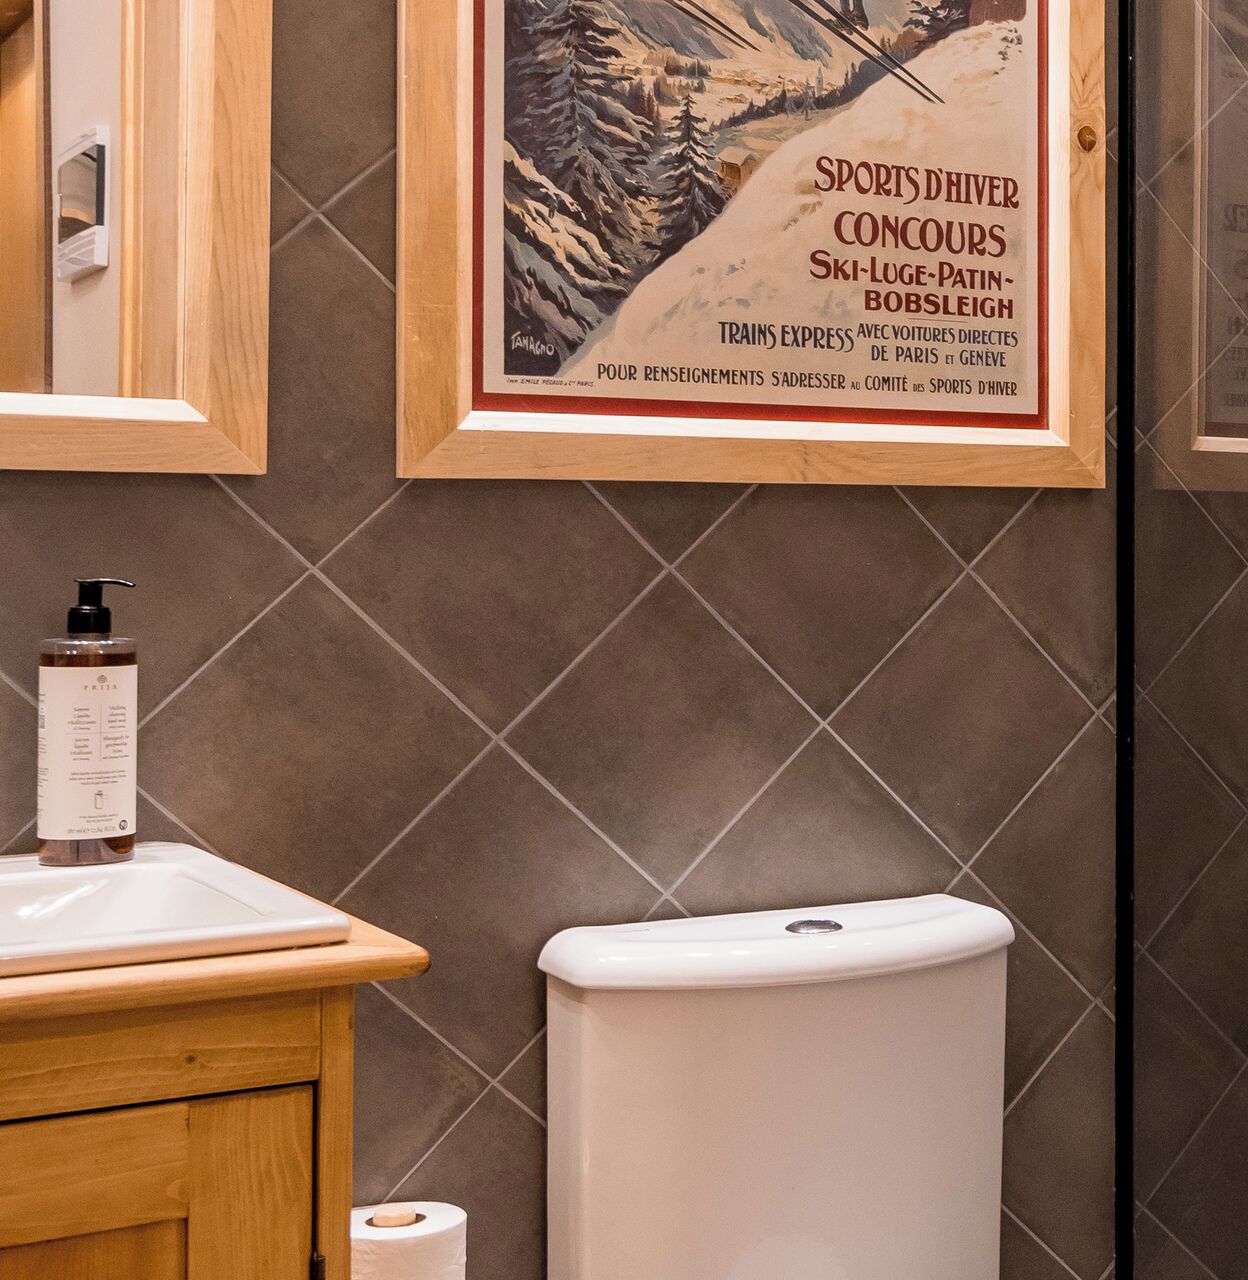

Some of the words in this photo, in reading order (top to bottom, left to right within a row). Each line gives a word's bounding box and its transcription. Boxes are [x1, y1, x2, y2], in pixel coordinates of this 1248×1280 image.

[814, 155, 922, 206] SPORTS
[923, 167, 1020, 210] D'HIVER
[833, 210, 1007, 259] CONCOURS
[864, 289, 1014, 320] BOBSLEIGH
[511, 331, 555, 356] TAMAGNO
[718, 320, 777, 350] TRAINS
[780, 324, 855, 354] EXPRESS
[856, 322, 891, 341] AVEC
[891, 324, 956, 345] VOITURES
[957, 328, 1019, 349] DIRECTES
[870, 344, 889, 363] DE
[895, 345, 939, 365] PARIS
[945, 354, 955, 365] ET
[959, 349, 1007, 369] GENÈVE
[597, 363, 638, 382] POUR
[643, 365, 765, 388] RENSEIGNEMENTS
[771, 369, 846, 391] S'ADRESSER
[850, 380, 861, 391] AU
[912, 382, 926, 393] DES
[928, 376, 973, 396] SPORTS
[978, 380, 1019, 398] D'HIVER
